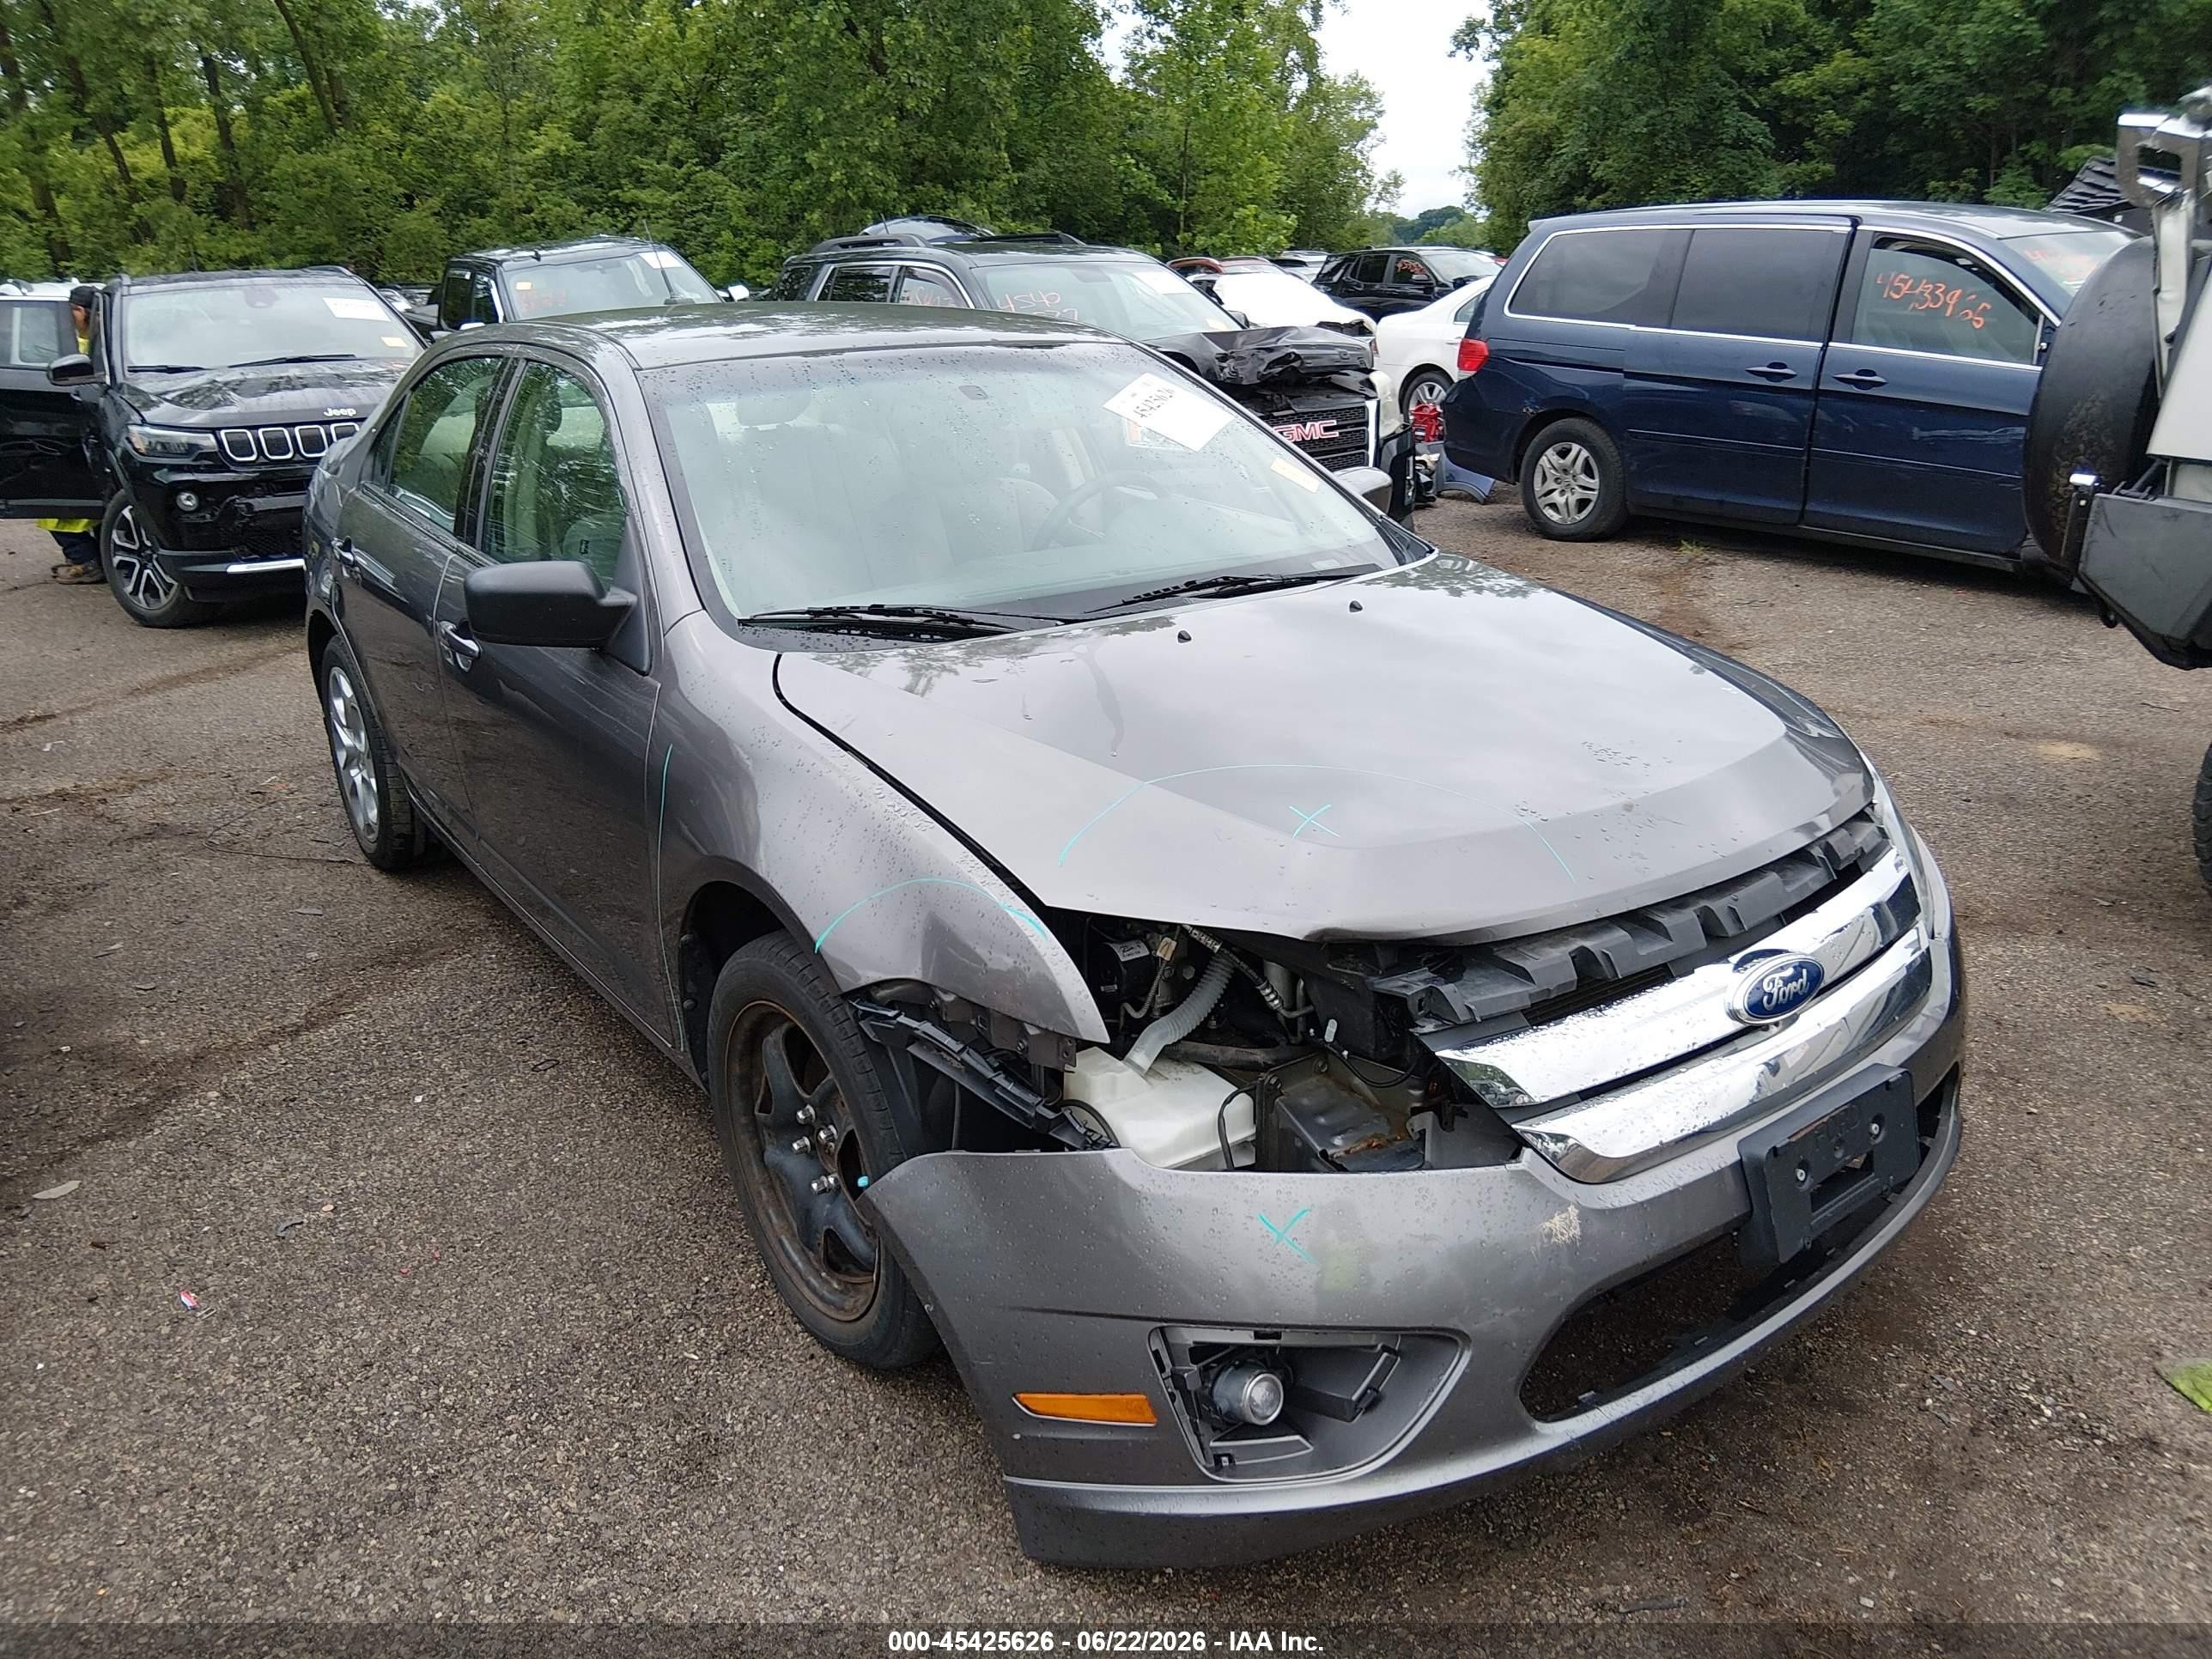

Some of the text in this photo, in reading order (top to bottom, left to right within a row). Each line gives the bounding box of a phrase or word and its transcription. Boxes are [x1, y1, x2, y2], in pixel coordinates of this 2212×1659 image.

[323, 407, 357, 417] Jeep
[1272, 419, 1340, 443] GMC
[1762, 966, 1811, 1012] Ford
